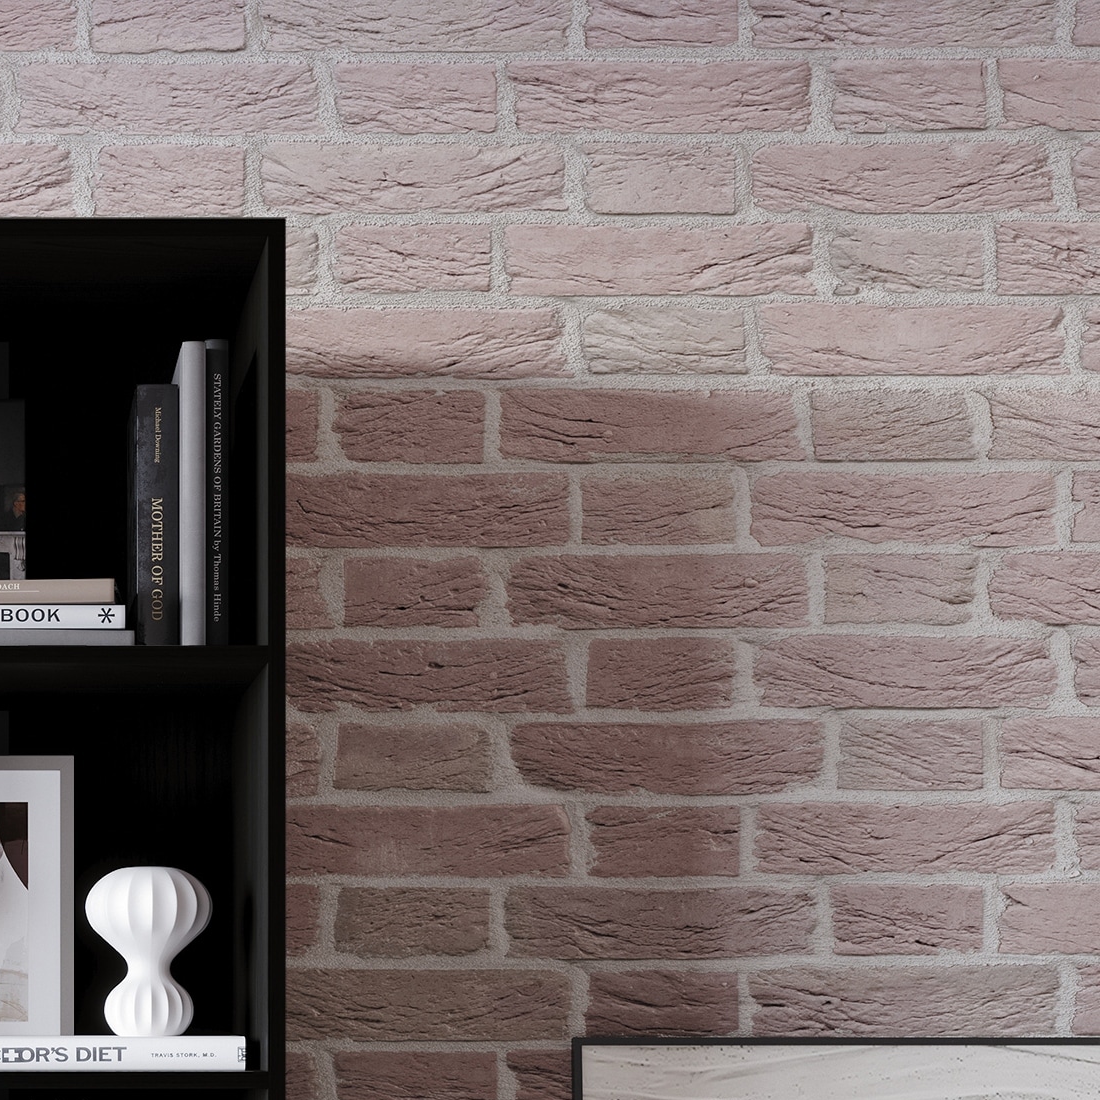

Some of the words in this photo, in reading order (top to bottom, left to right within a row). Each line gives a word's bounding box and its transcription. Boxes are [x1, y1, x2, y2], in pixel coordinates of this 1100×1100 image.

[213, 373, 222, 420] STATELY
[154, 407, 162, 433] Michael
[153, 434, 162, 464] Downing
[213, 421, 222, 474] GARDENS
[213, 476, 222, 491] OF
[151, 497, 163, 561] MOTHER
[213, 493, 222, 538] BRITAIN
[211, 539, 222, 552] by
[151, 565, 163, 586] OF
[213, 553, 223, 591] Thomas
[0, 608, 61, 623] BOOK
[151, 588, 163, 621] GOD
[213, 593, 222, 622] Hinde
[75, 1046, 128, 1063] DIET
